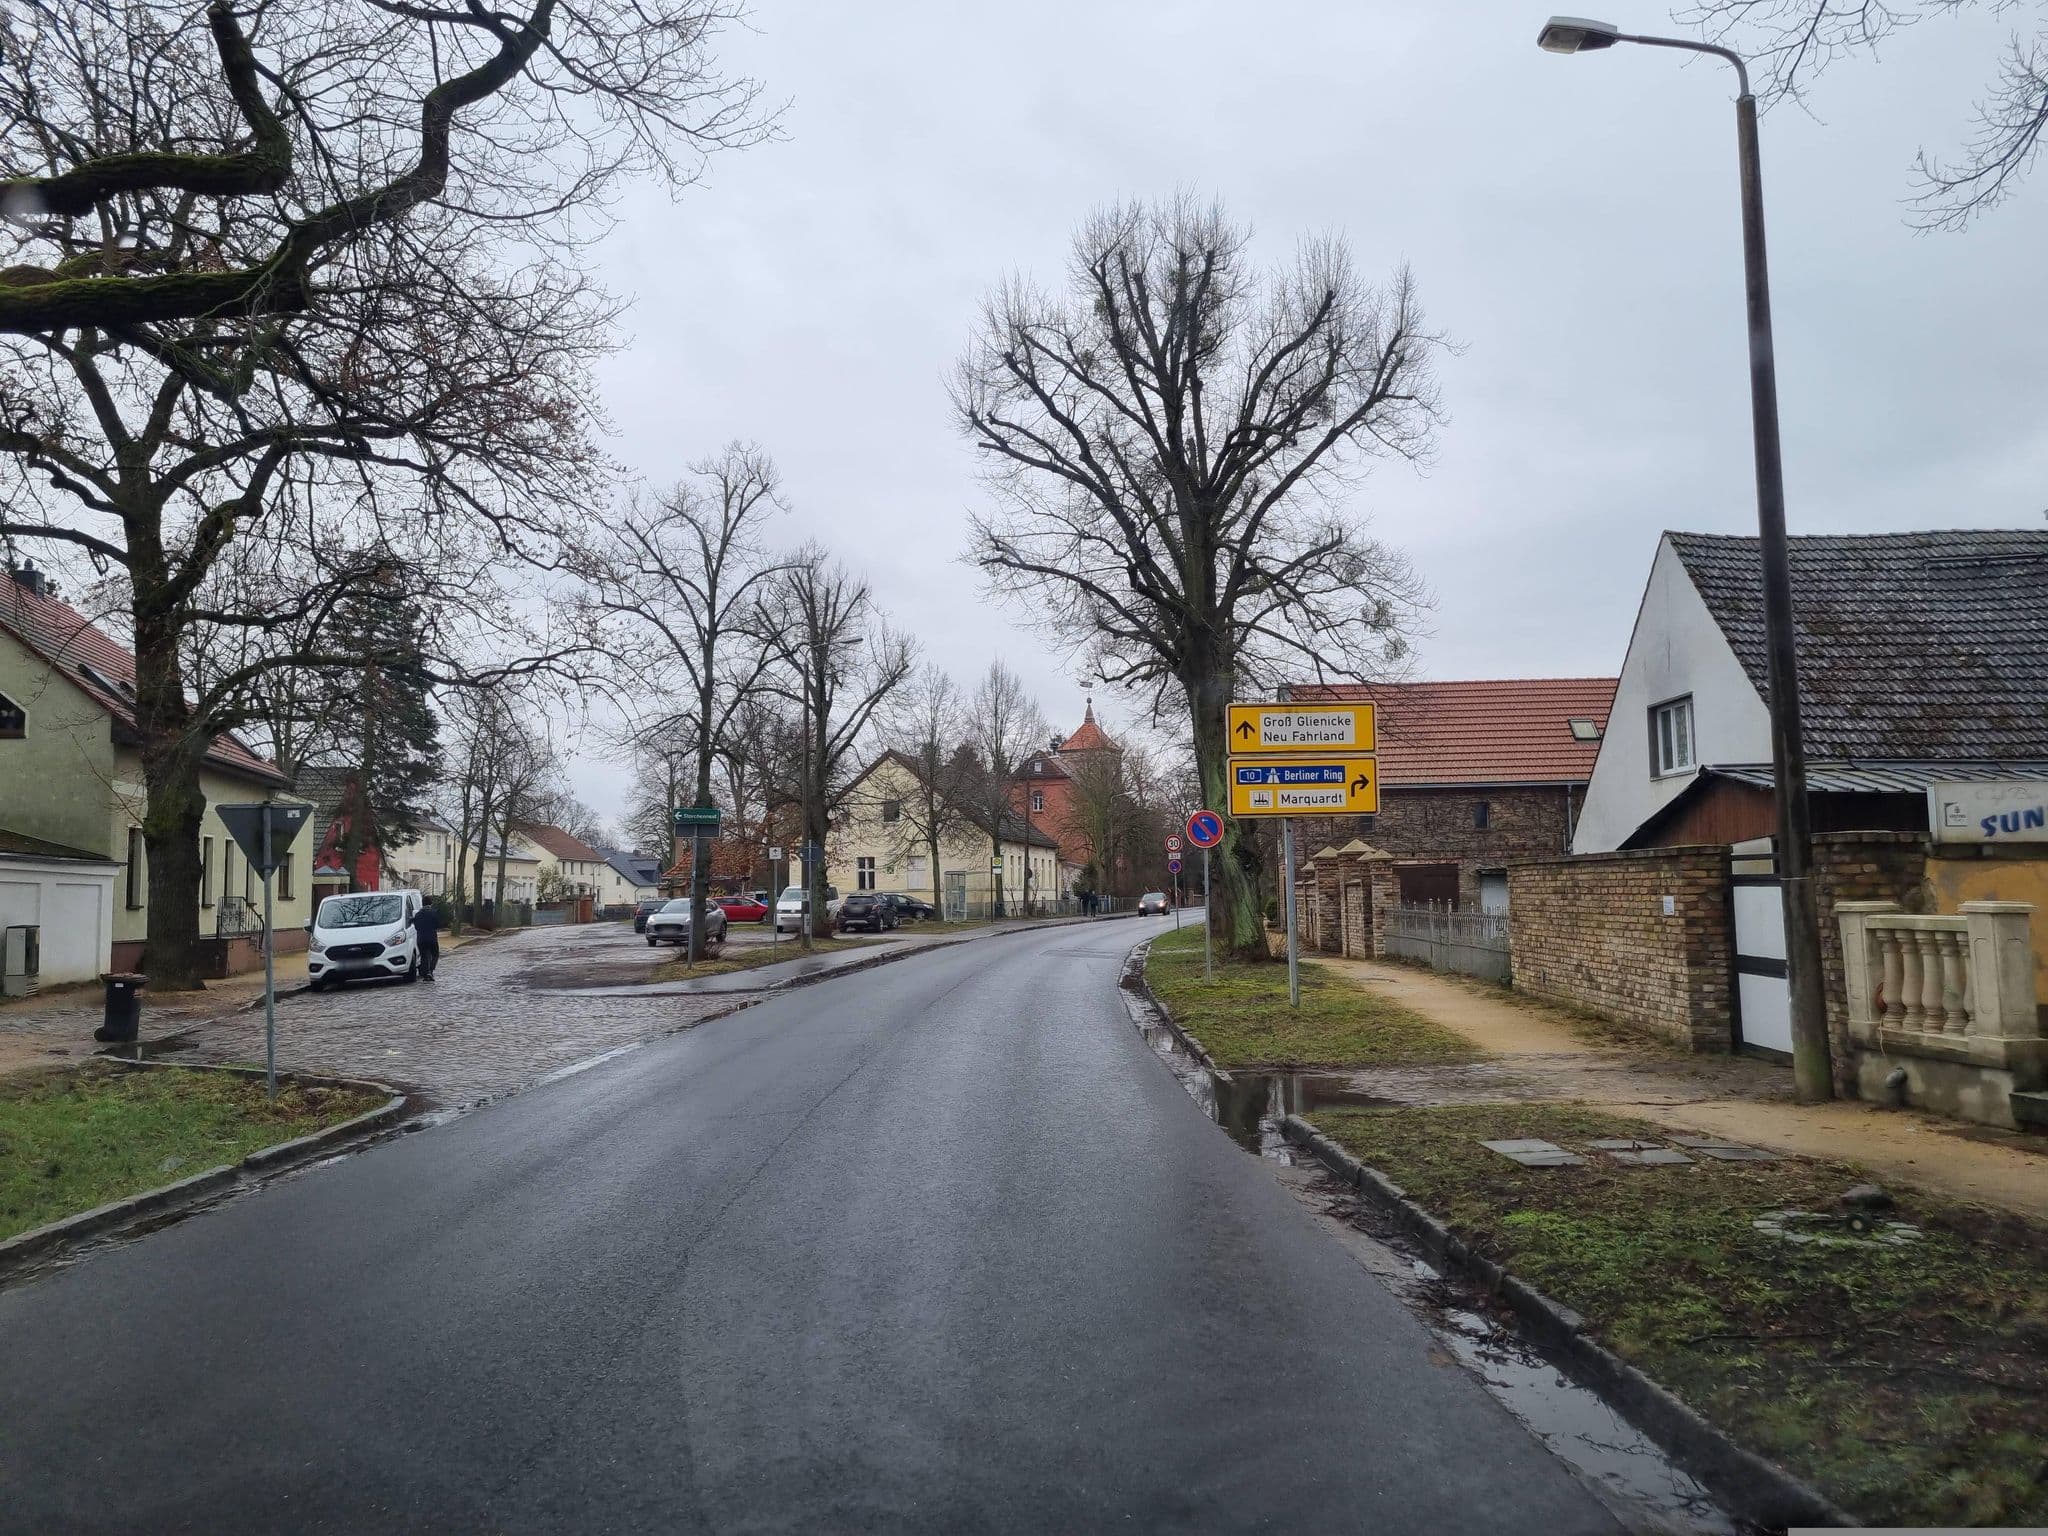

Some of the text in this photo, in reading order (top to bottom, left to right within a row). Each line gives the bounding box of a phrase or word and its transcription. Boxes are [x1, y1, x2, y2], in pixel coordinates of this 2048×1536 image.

[1263, 715, 1351, 727] Groß Glienicke
[1264, 730, 1345, 742] Neu Fahrland
[1246, 769, 1343, 782] 10 Berliner Ring
[1281, 793, 1343, 806] Marquardt
[1980, 806, 2045, 837] SUN
[1169, 839, 1178, 848] 30
